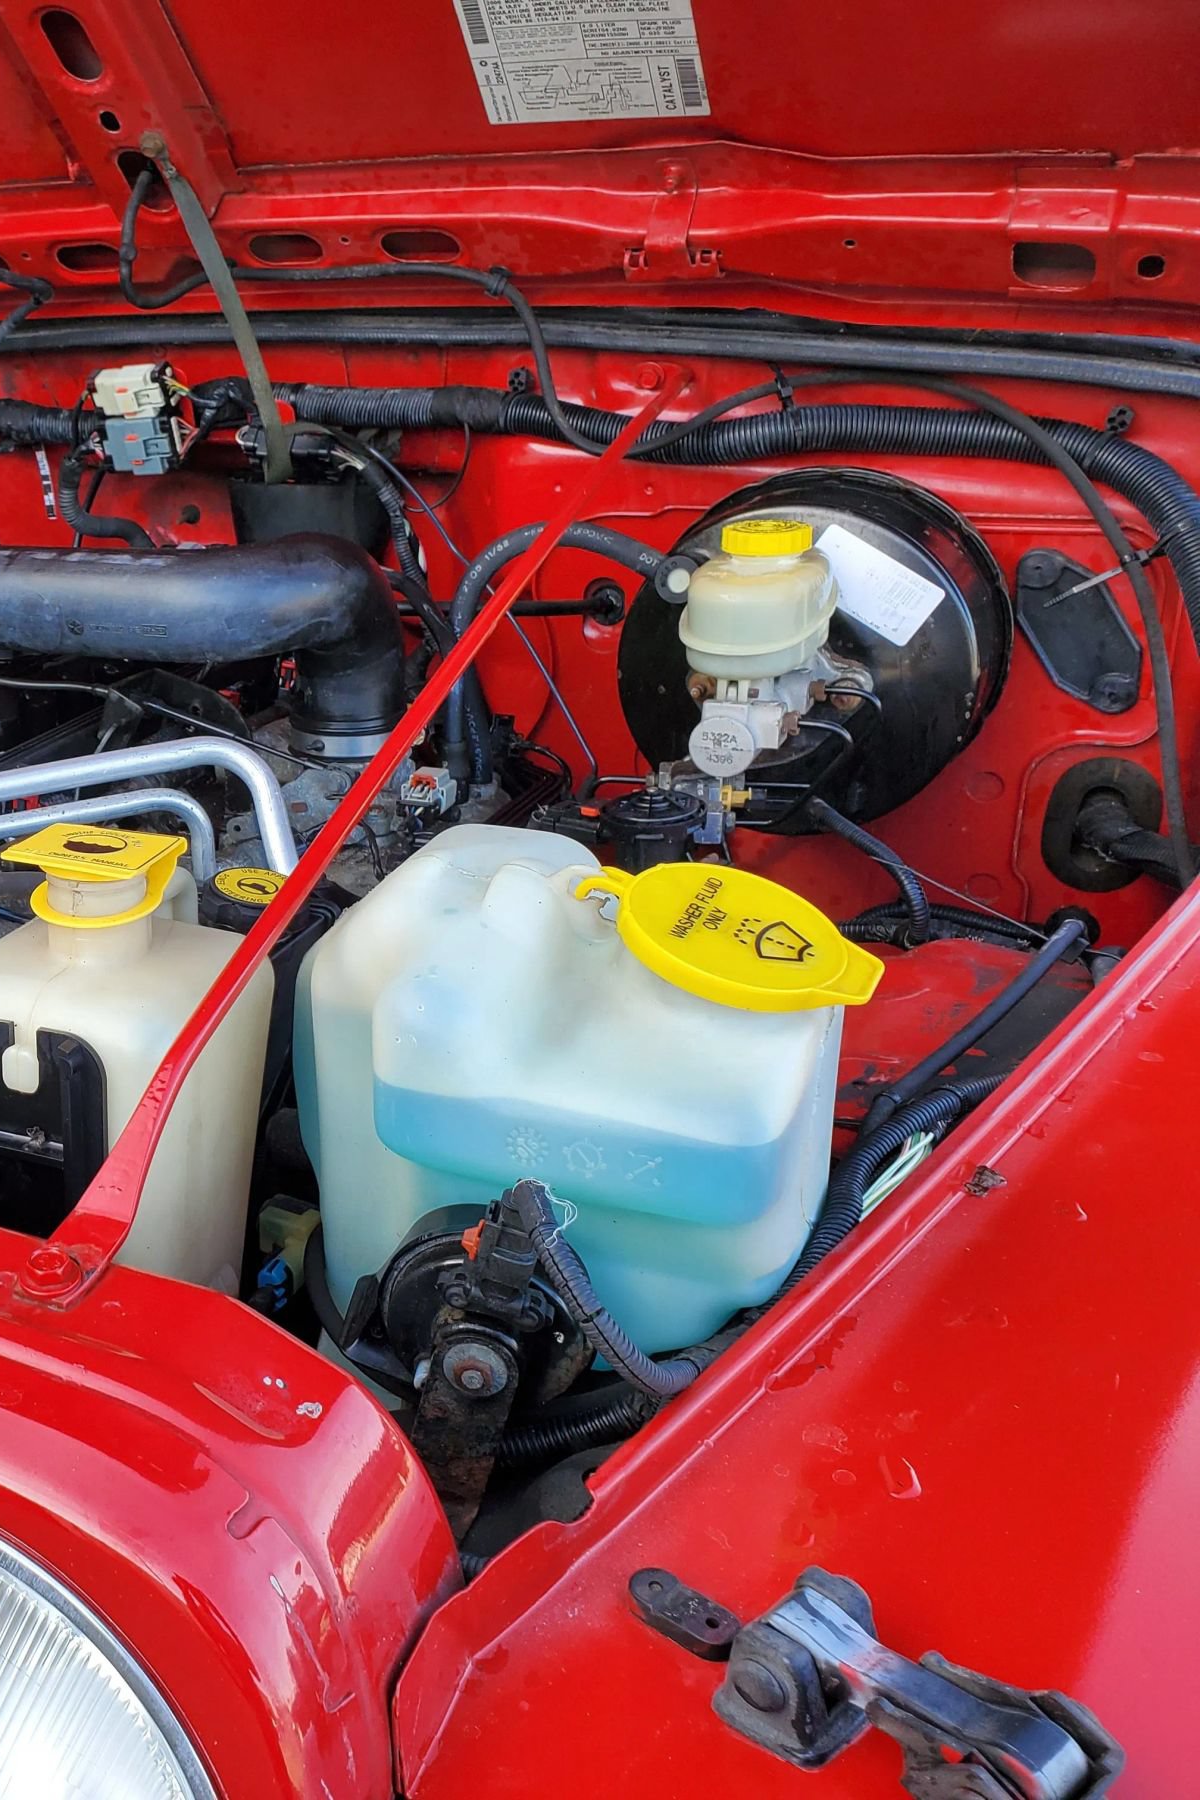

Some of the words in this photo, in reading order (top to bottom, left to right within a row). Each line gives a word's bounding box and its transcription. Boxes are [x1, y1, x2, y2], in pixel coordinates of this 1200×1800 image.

[657, 65, 676, 110] CATALYST
[639, 552, 660, 567] DOT
[91, 858, 130, 868] MANUAL
[221, 887, 264, 903] STEERING
[668, 903, 706, 939] WASHER
[695, 876, 723, 905] FLUID
[702, 906, 728, 931] ONLY
